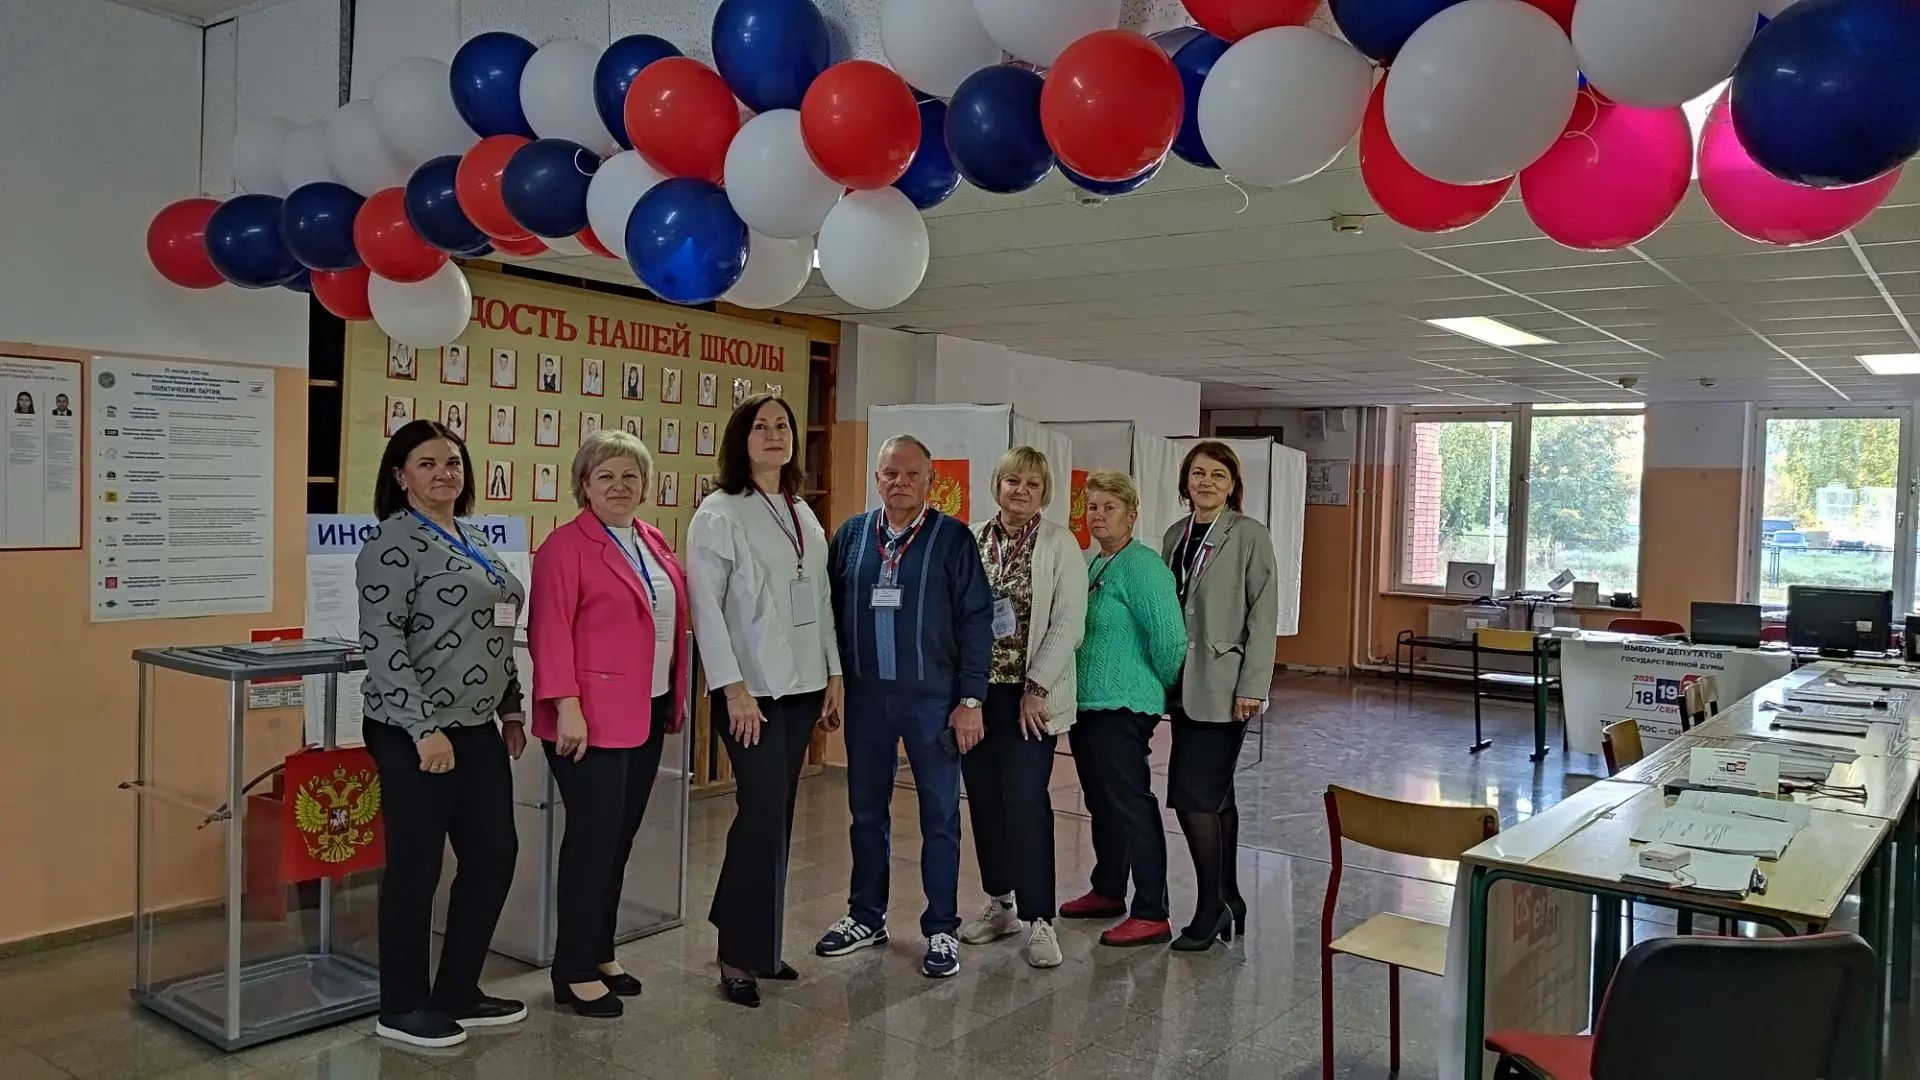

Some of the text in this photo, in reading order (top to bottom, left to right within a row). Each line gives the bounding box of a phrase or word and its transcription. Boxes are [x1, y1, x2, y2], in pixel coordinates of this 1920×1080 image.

[470, 295, 785, 372] ДОСТЬ НАШЕЙ ШКОЛЫ
[151, 384, 197, 394] ПОЛИТИЧЕСКИЕ
[1624, 644, 1723, 660] ВЫБОРЫ ДЕПУТАТОВ
[1621, 656, 1724, 671] ГОСУДАРСТВЕННОЙ ДУМЫ
[1635, 690, 1654, 705] 18
[1658, 685, 1678, 700] 19
[1639, 724, 1657, 733] ЛОС
